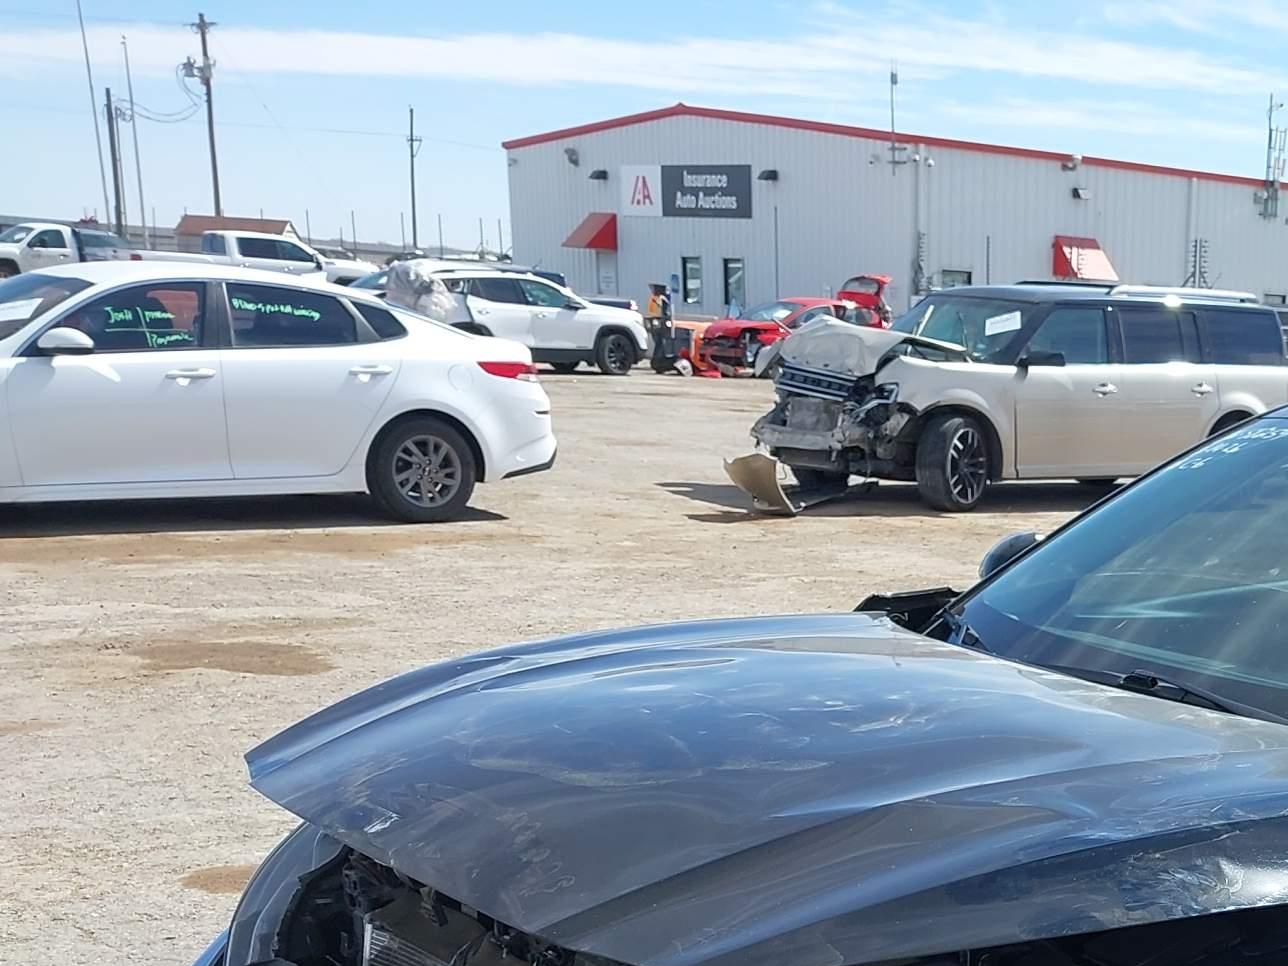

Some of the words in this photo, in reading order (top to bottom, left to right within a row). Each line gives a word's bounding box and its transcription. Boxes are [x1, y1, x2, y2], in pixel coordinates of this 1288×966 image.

[682, 170, 728, 188] Insurance
[675, 190, 697, 209] Auto
[698, 190, 738, 209] Auctions
